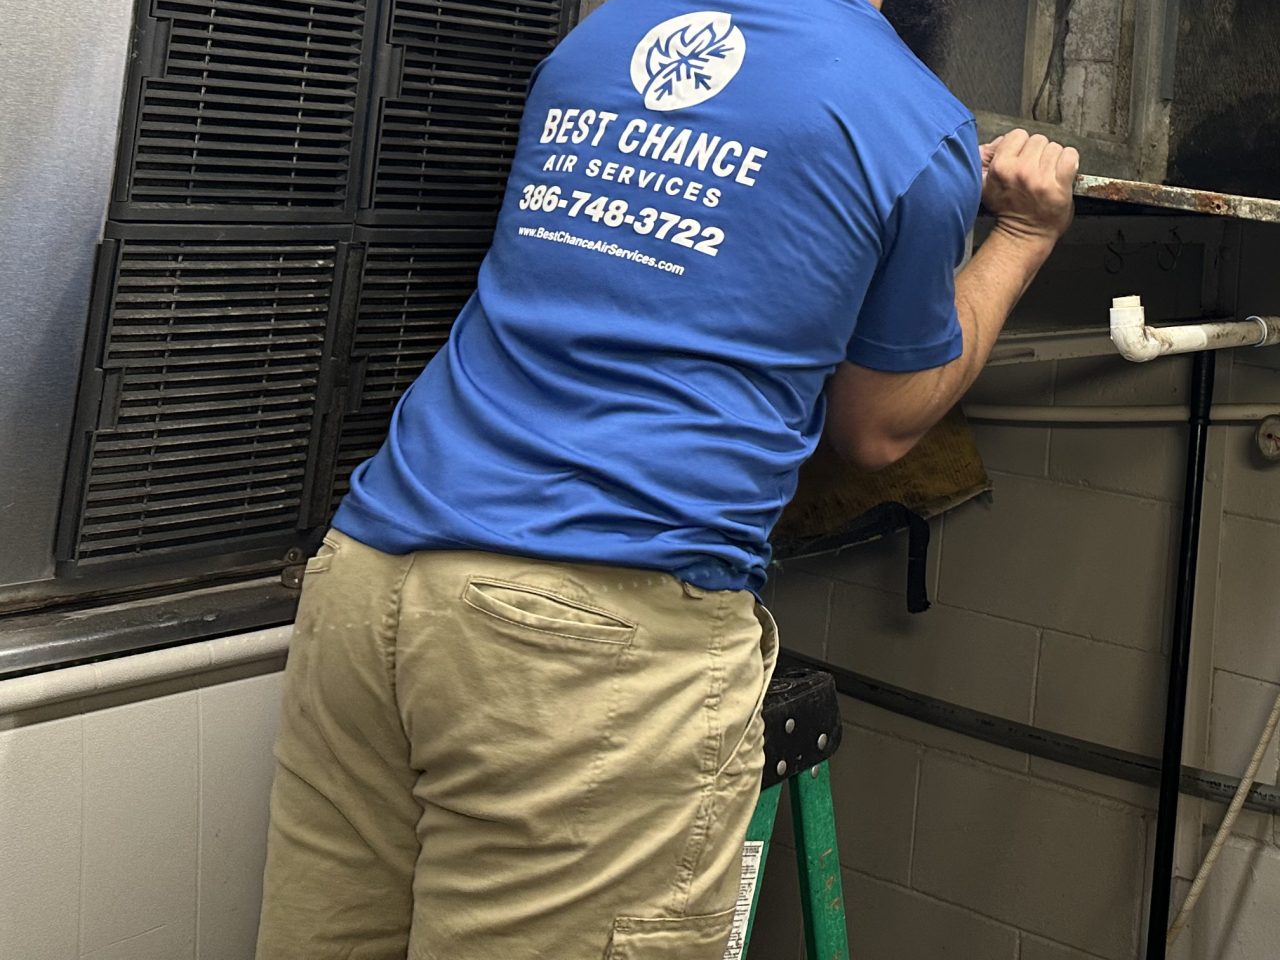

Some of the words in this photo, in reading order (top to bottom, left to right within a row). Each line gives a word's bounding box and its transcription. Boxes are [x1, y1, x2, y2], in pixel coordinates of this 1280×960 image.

[540, 108, 618, 148] BEST
[617, 118, 768, 187] CHANCE
[542, 154, 578, 173] AIR
[585, 158, 722, 208] SERVICES
[518, 184, 725, 257] 386-748-3722
[518, 226, 685, 276] www.BestChanceAirServices.com
